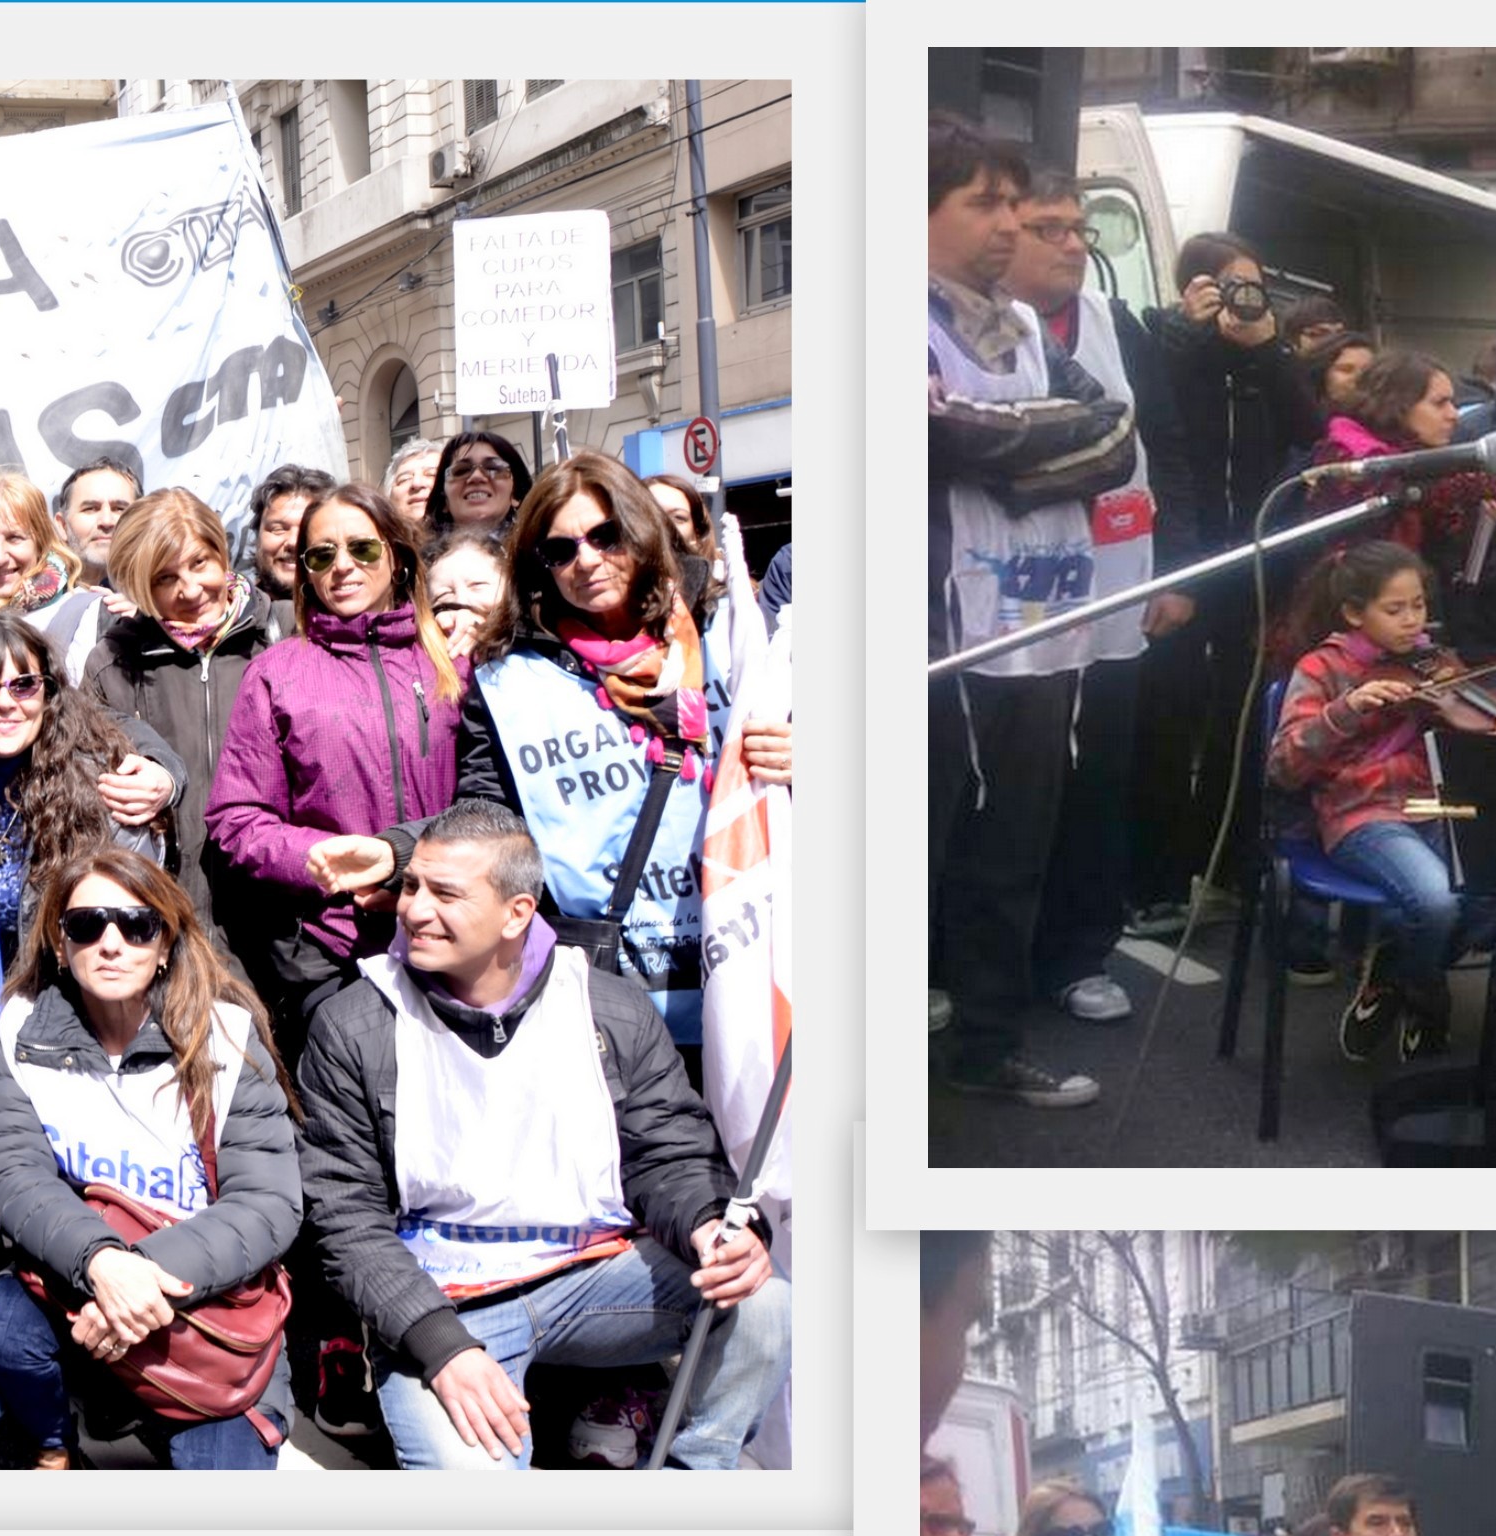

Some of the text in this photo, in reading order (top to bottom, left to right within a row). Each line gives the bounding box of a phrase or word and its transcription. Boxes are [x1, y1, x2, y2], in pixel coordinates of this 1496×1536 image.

[470, 227, 585, 252] FALTA DE
[482, 253, 573, 275] CUPOS
[494, 279, 562, 300] PARA
[461, 302, 596, 328] COMEDOR
[521, 331, 535, 347] Y
[160, 335, 308, 459] CTA
[499, 384, 546, 405] Suteba
